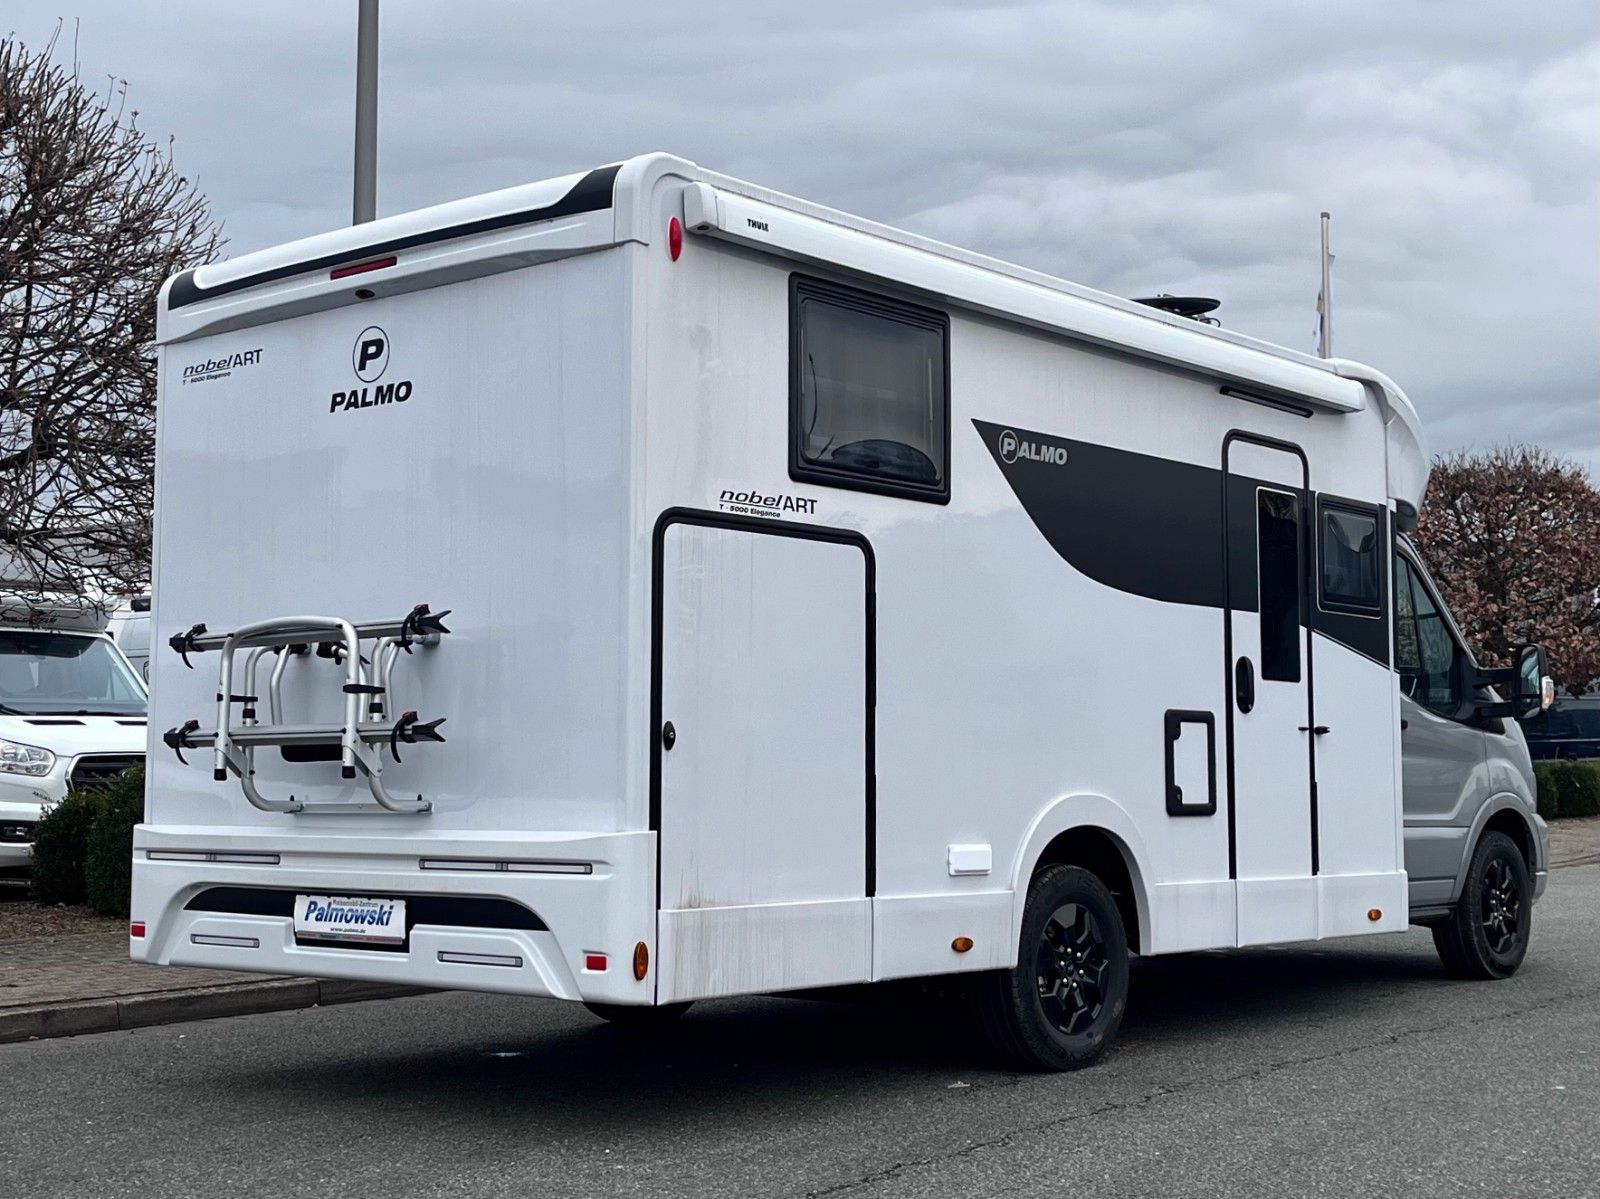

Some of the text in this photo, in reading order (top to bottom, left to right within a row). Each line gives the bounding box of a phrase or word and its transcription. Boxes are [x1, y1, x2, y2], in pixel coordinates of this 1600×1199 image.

[746, 218, 769, 232] THULE
[357, 338, 385, 372] P
[330, 380, 413, 414] PALMO
[1001, 434, 1068, 465] PALMO
[719, 490, 818, 514] nobelART
[729, 505, 749, 513] 5000
[750, 507, 781, 518] Elegance
[304, 900, 394, 926] Palmowski
